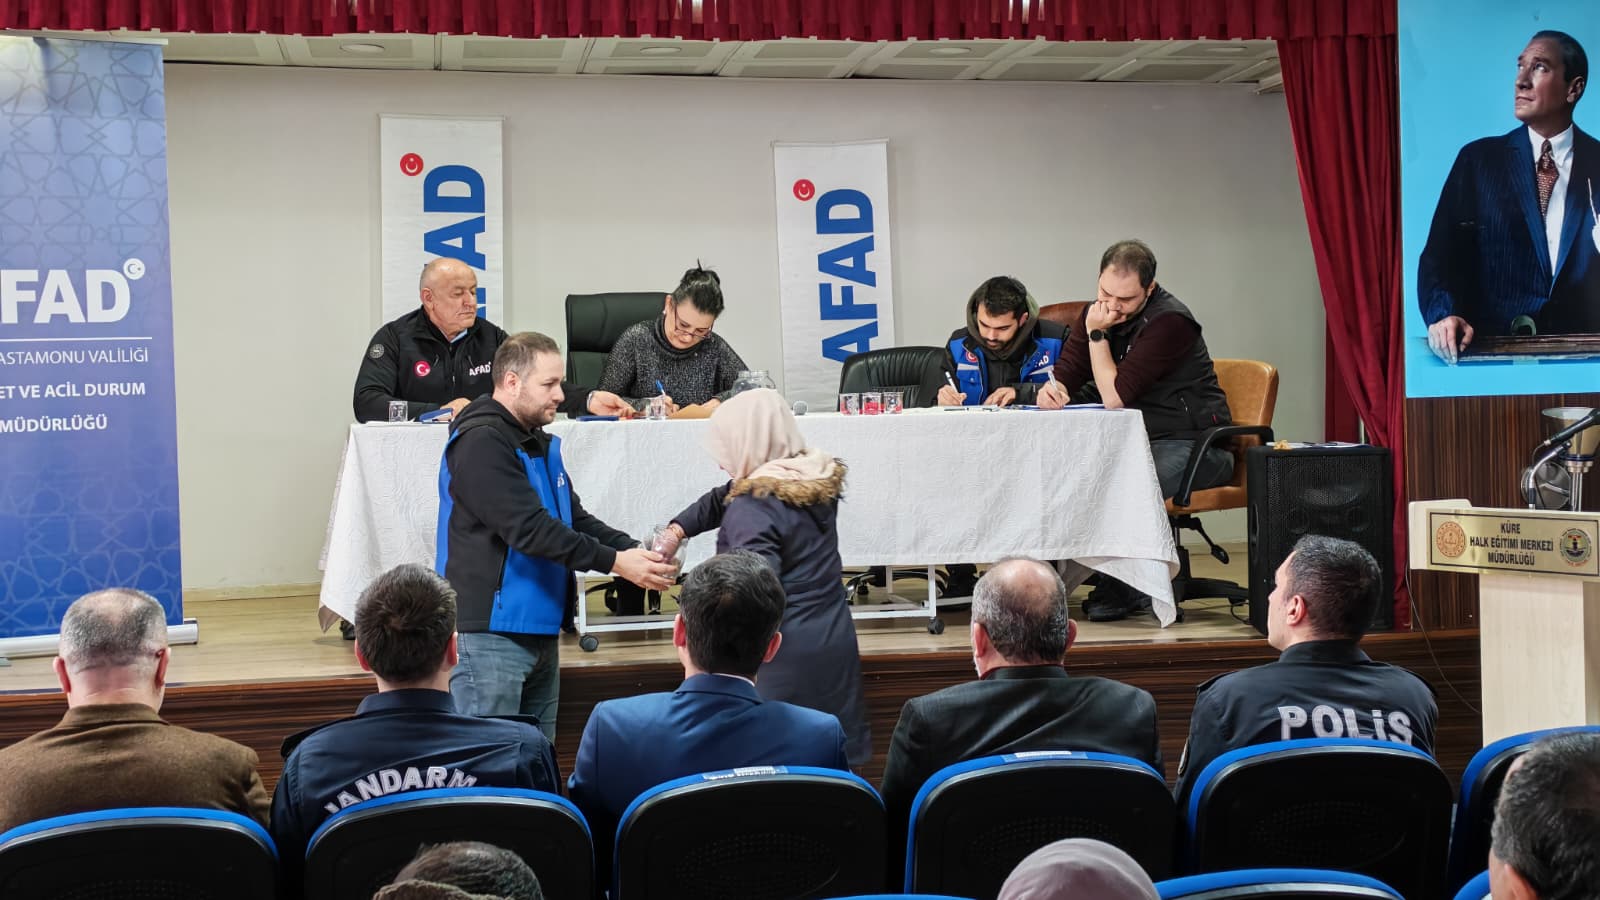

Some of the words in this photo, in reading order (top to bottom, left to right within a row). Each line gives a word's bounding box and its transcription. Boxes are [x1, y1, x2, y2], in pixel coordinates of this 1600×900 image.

[816, 189, 878, 363] AFAD
[88, 347, 149, 363] VALİLİĞİ
[469, 364, 490, 376] AFAD
[19, 384, 40, 398] VE
[44, 381, 80, 397] ACİL
[84, 382, 146, 397] DURUM
[0, 414, 108, 432] MÜDÜRLÜĞÜ
[1500, 520, 1521, 534] KÜRE
[1469, 536, 1489, 548] HALK
[1491, 535, 1519, 550] EĞİTİMİ
[1487, 550, 1535, 566] MÜDÜRLÜĞÜ
